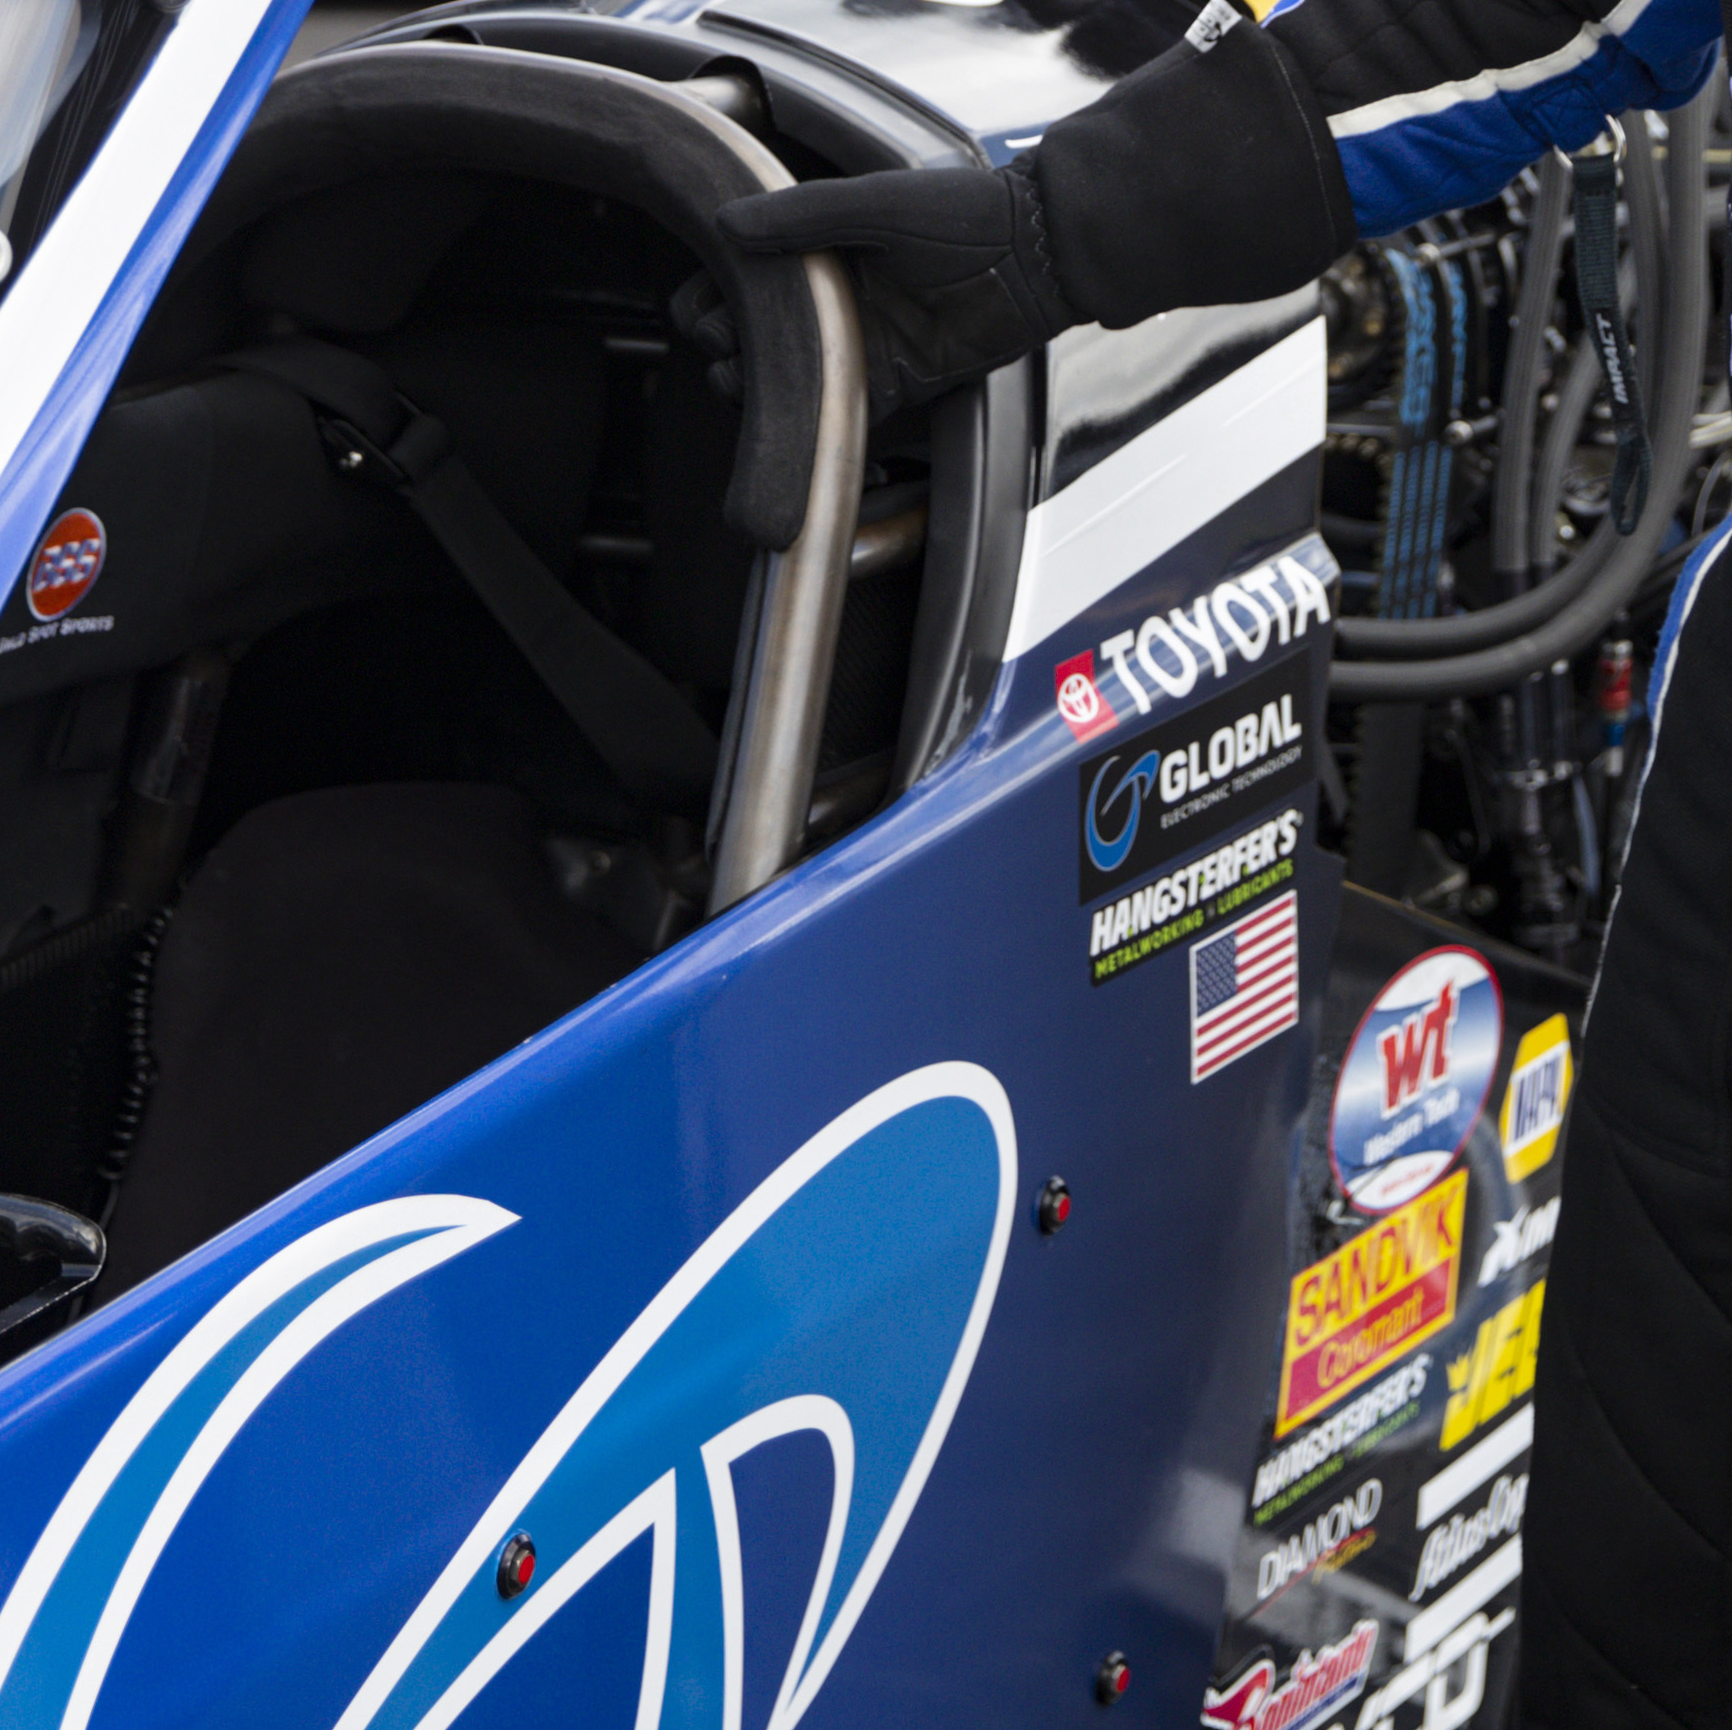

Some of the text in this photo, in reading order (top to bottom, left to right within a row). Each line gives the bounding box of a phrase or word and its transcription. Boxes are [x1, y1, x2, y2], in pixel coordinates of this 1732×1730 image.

[1100, 555, 1332, 716] TOYOTA
[1159, 693, 1303, 804] GLOBAL
[1160, 745, 1303, 830] ELECTRONIC TECHNOLOGY
[1089, 808, 1299, 957] HANGSTERFER'S
[1094, 857, 1295, 979] METALWORKING LUBRICANTS
[1295, 1182, 1459, 1349] SANDVIK
[1318, 1286, 1426, 1389] Coromant
[1257, 1478, 1383, 1600] DIAMOND
